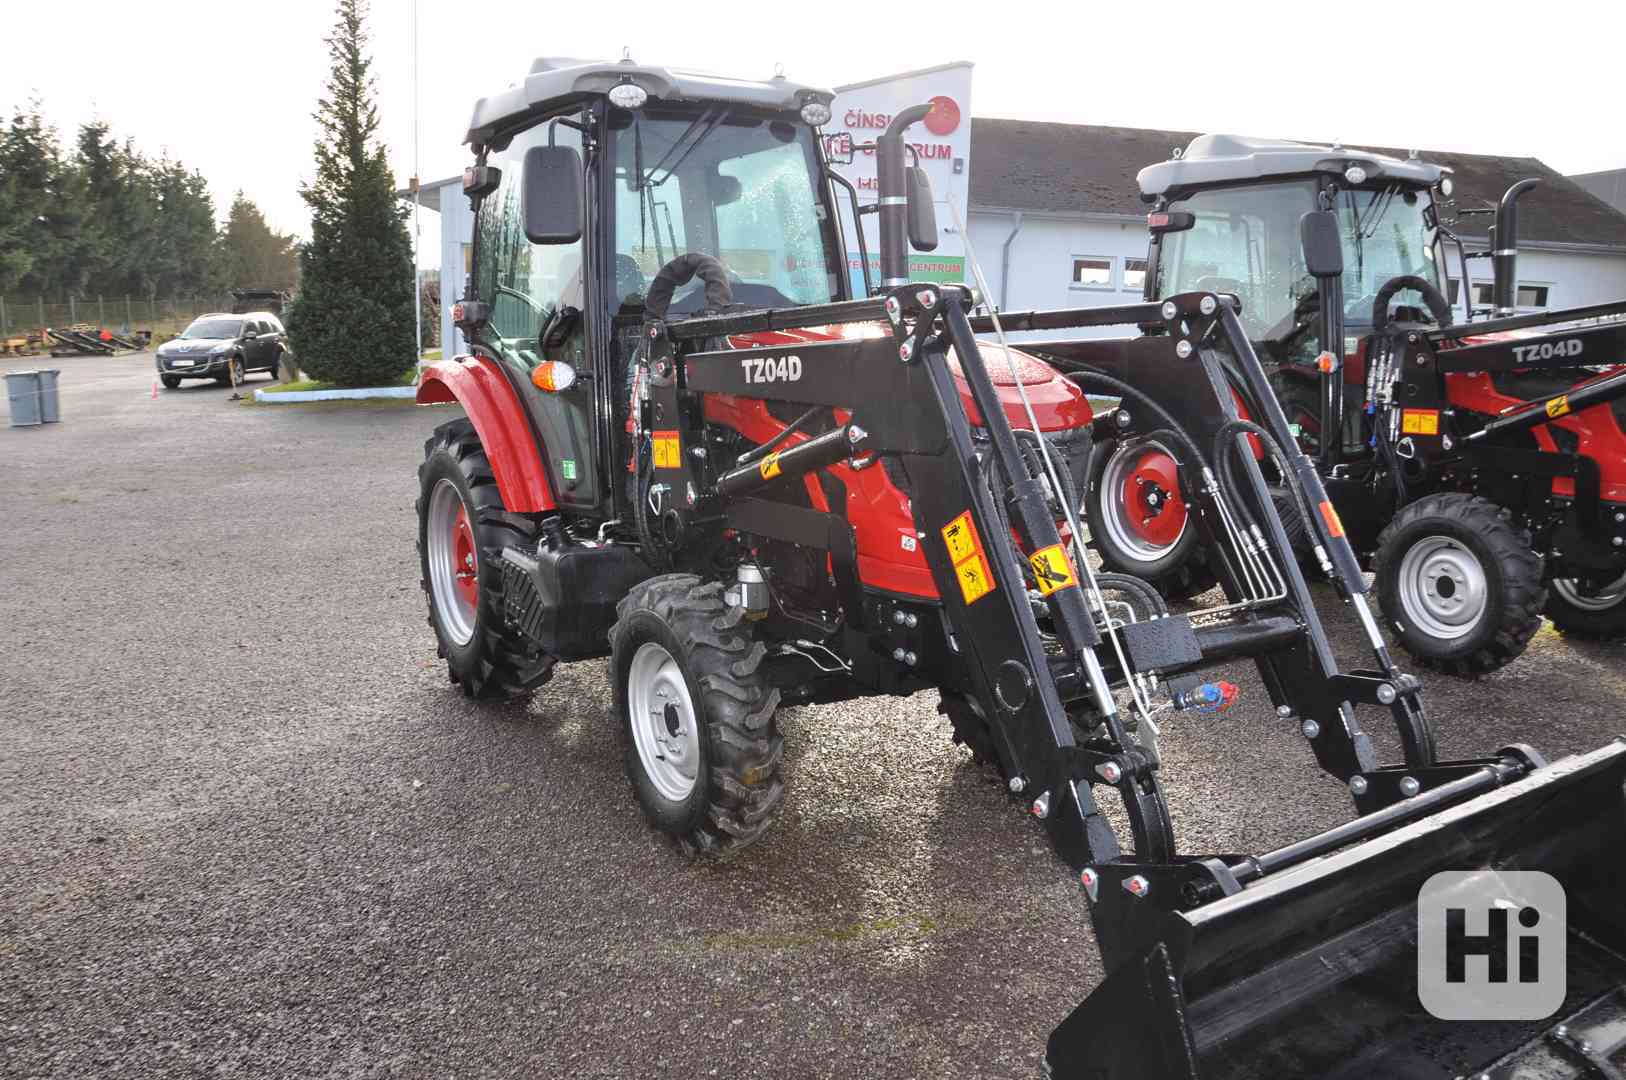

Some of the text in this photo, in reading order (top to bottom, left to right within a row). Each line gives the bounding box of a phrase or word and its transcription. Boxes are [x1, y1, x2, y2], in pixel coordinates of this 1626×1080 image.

[844, 108, 897, 128] ČÍNS
[863, 140, 952, 161] CRUM
[1512, 339, 1583, 362] TZ04D
[741, 355, 802, 384] TZ04D
